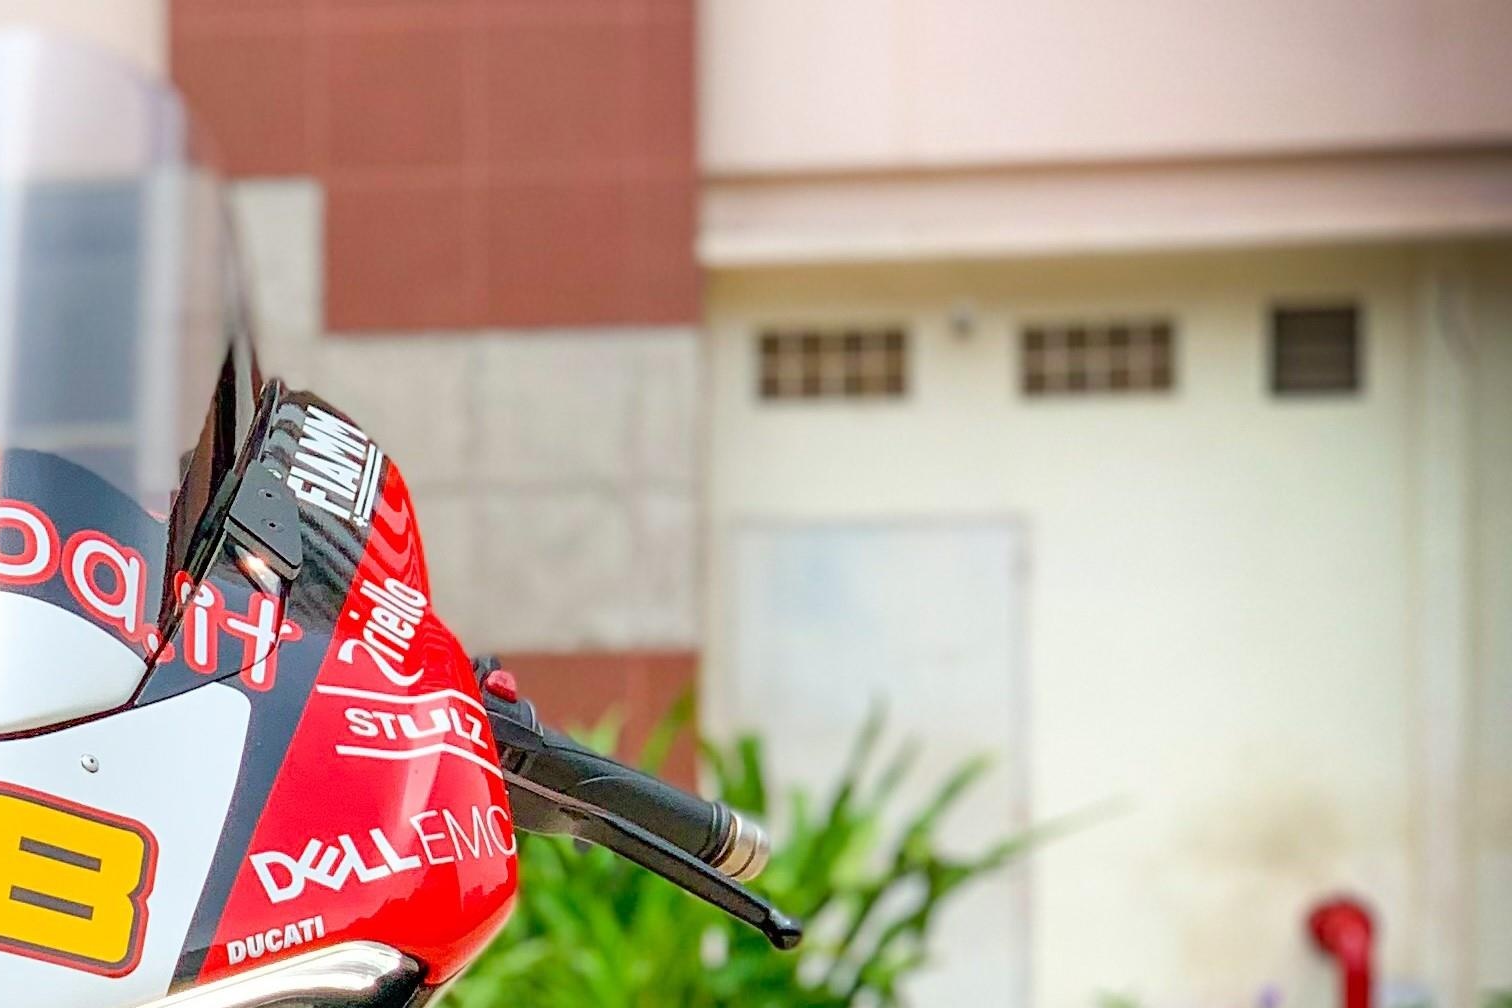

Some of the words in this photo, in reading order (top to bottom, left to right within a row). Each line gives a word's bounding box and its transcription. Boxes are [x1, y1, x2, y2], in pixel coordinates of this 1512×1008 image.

[286, 404, 368, 520] FIAMM
[344, 707, 489, 749] STULZ
[249, 827, 421, 903] DELL
[412, 805, 516, 864] EMC
[227, 915, 325, 965] DUCATI
